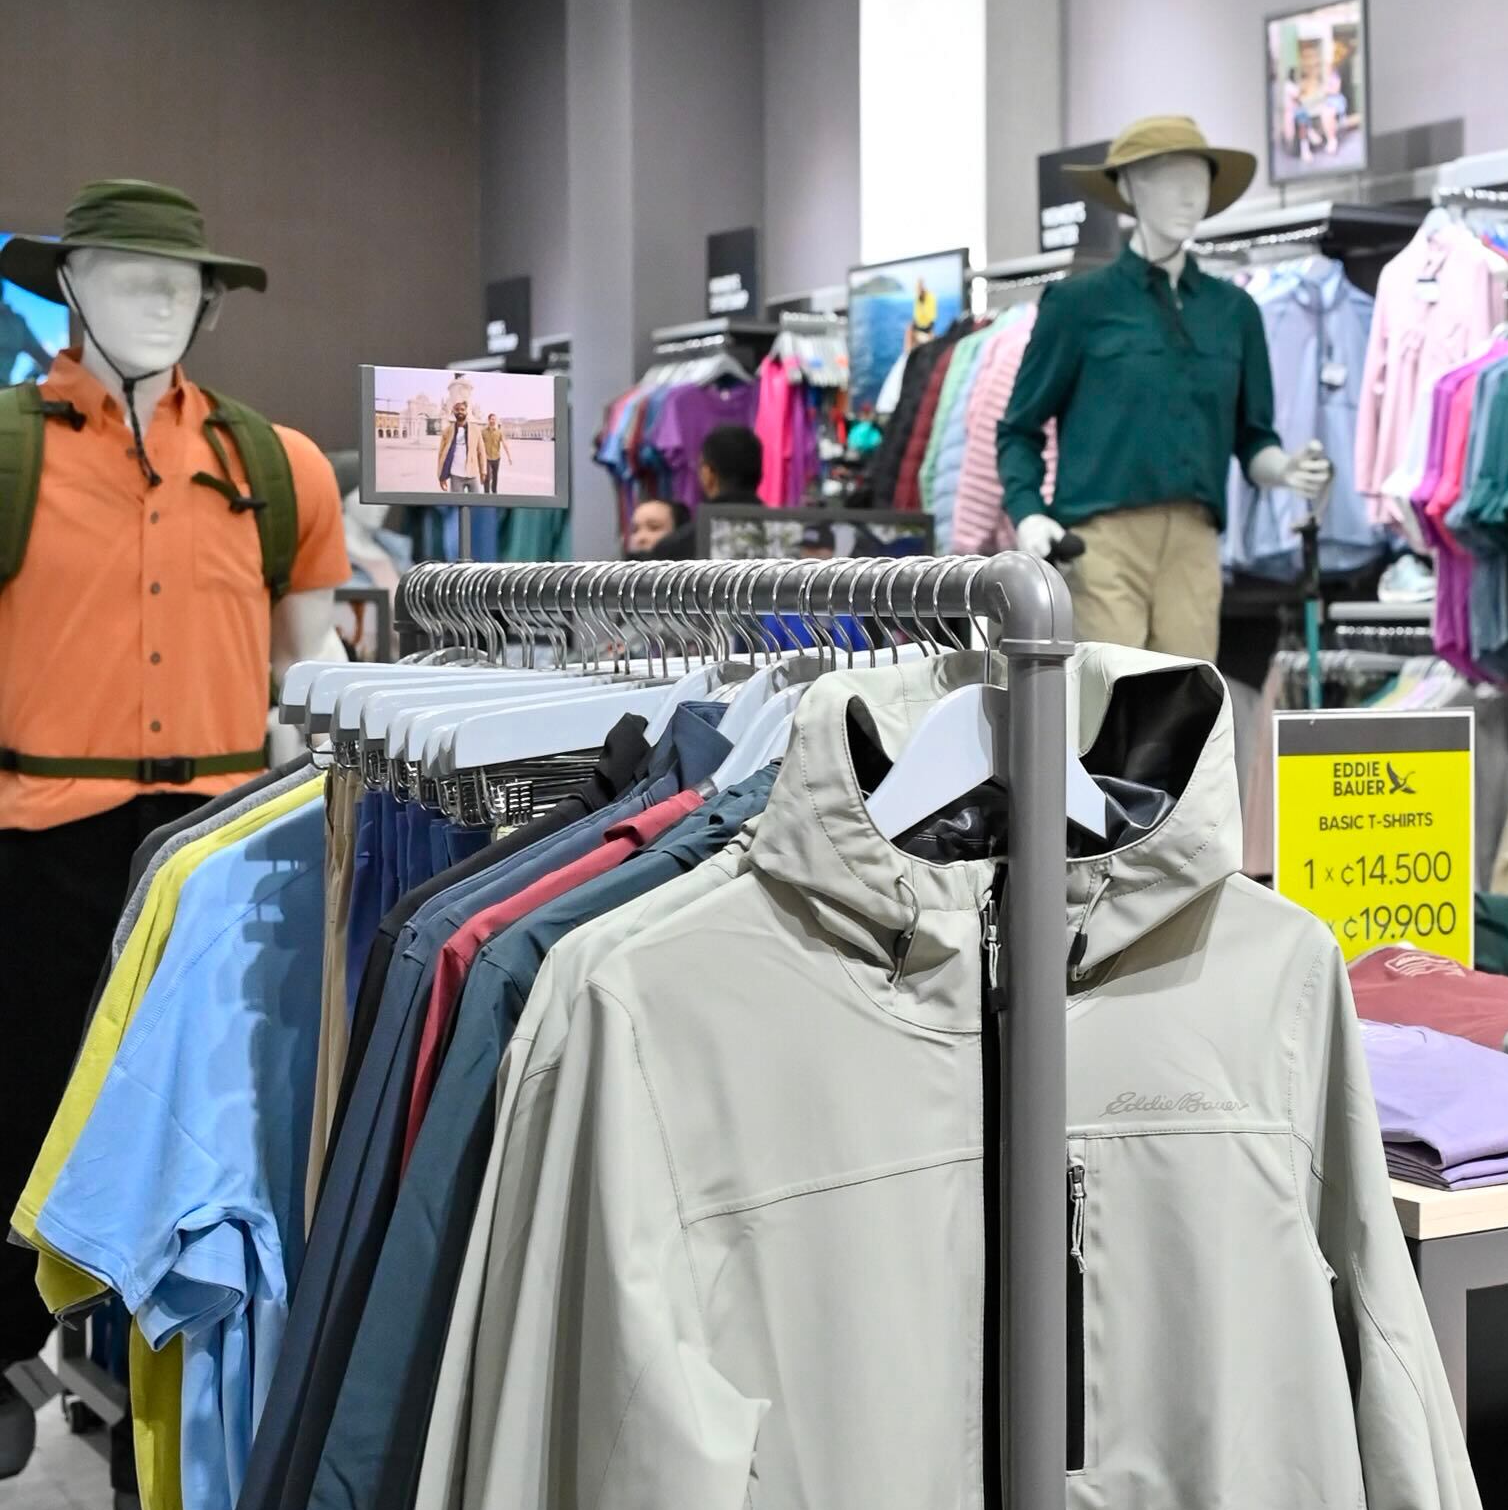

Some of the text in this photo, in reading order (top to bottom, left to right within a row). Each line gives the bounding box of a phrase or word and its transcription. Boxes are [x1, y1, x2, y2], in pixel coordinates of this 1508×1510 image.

[1333, 761, 1380, 779] EDDIE
[1333, 779, 1385, 797] BAUER
[1319, 812, 1434, 831] BASIC T-SHIRTS
[1303, 859, 1314, 889] 1
[1099, 1091, 1249, 1118] Eddie Bauer
